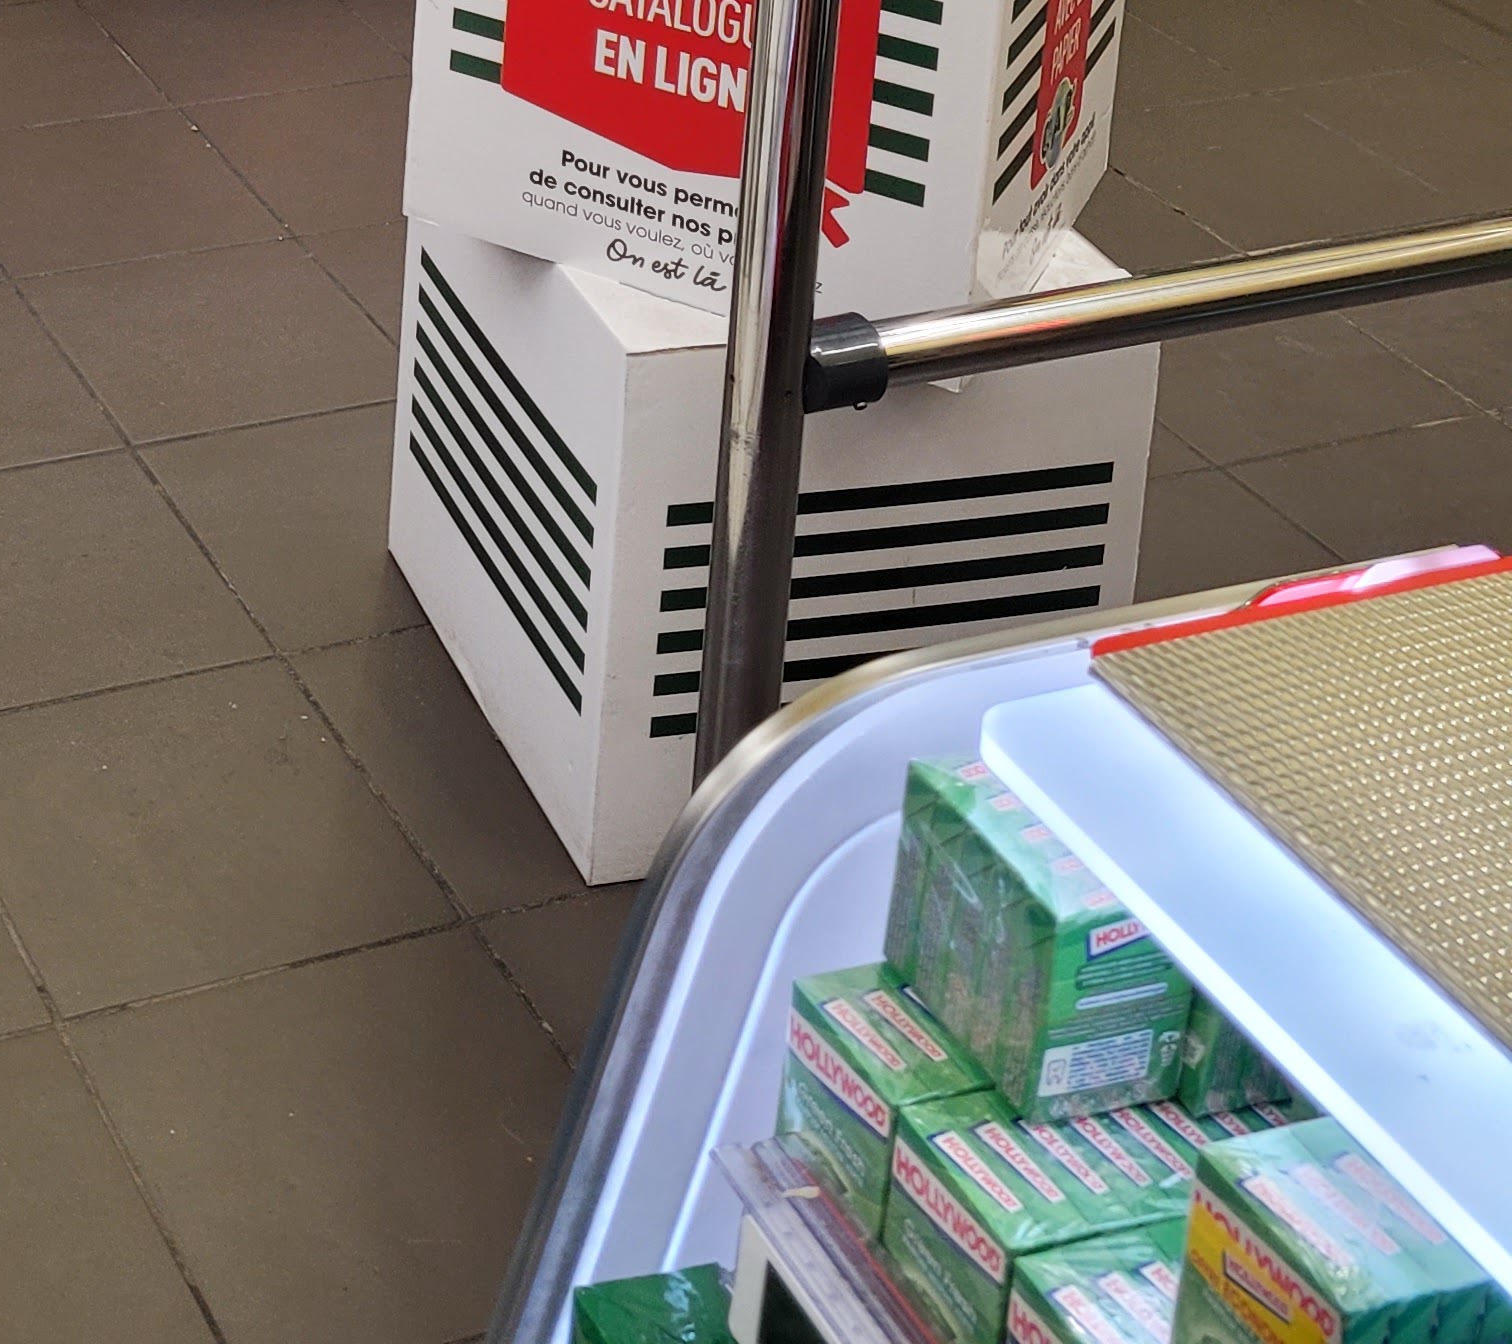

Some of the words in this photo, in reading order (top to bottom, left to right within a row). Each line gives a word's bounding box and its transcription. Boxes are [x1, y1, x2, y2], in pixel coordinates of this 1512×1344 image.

[594, 28, 646, 85] EN
[654, 45, 748, 113] LIGN
[1050, 17, 1082, 86] PAPIER
[529, 168, 558, 190] de
[563, 179, 666, 223] consulter
[671, 214, 711, 238] nos
[561, 149, 611, 180] Pour
[616, 168, 668, 198] vous
[521, 189, 578, 218] quand
[582, 208, 622, 231] vous
[626, 221, 685, 252] voulez,
[691, 242, 714, 261] où
[606, 238, 645, 269] On
[651, 256, 689, 280] est
[829, 997, 902, 1070] HOLLYWOOD
[869, 989, 943, 1059] HOLLYWOOD
[789, 1016, 887, 1129] HOLLYWOOD
[984, 1121, 1061, 1201] HOLLYWOOD
